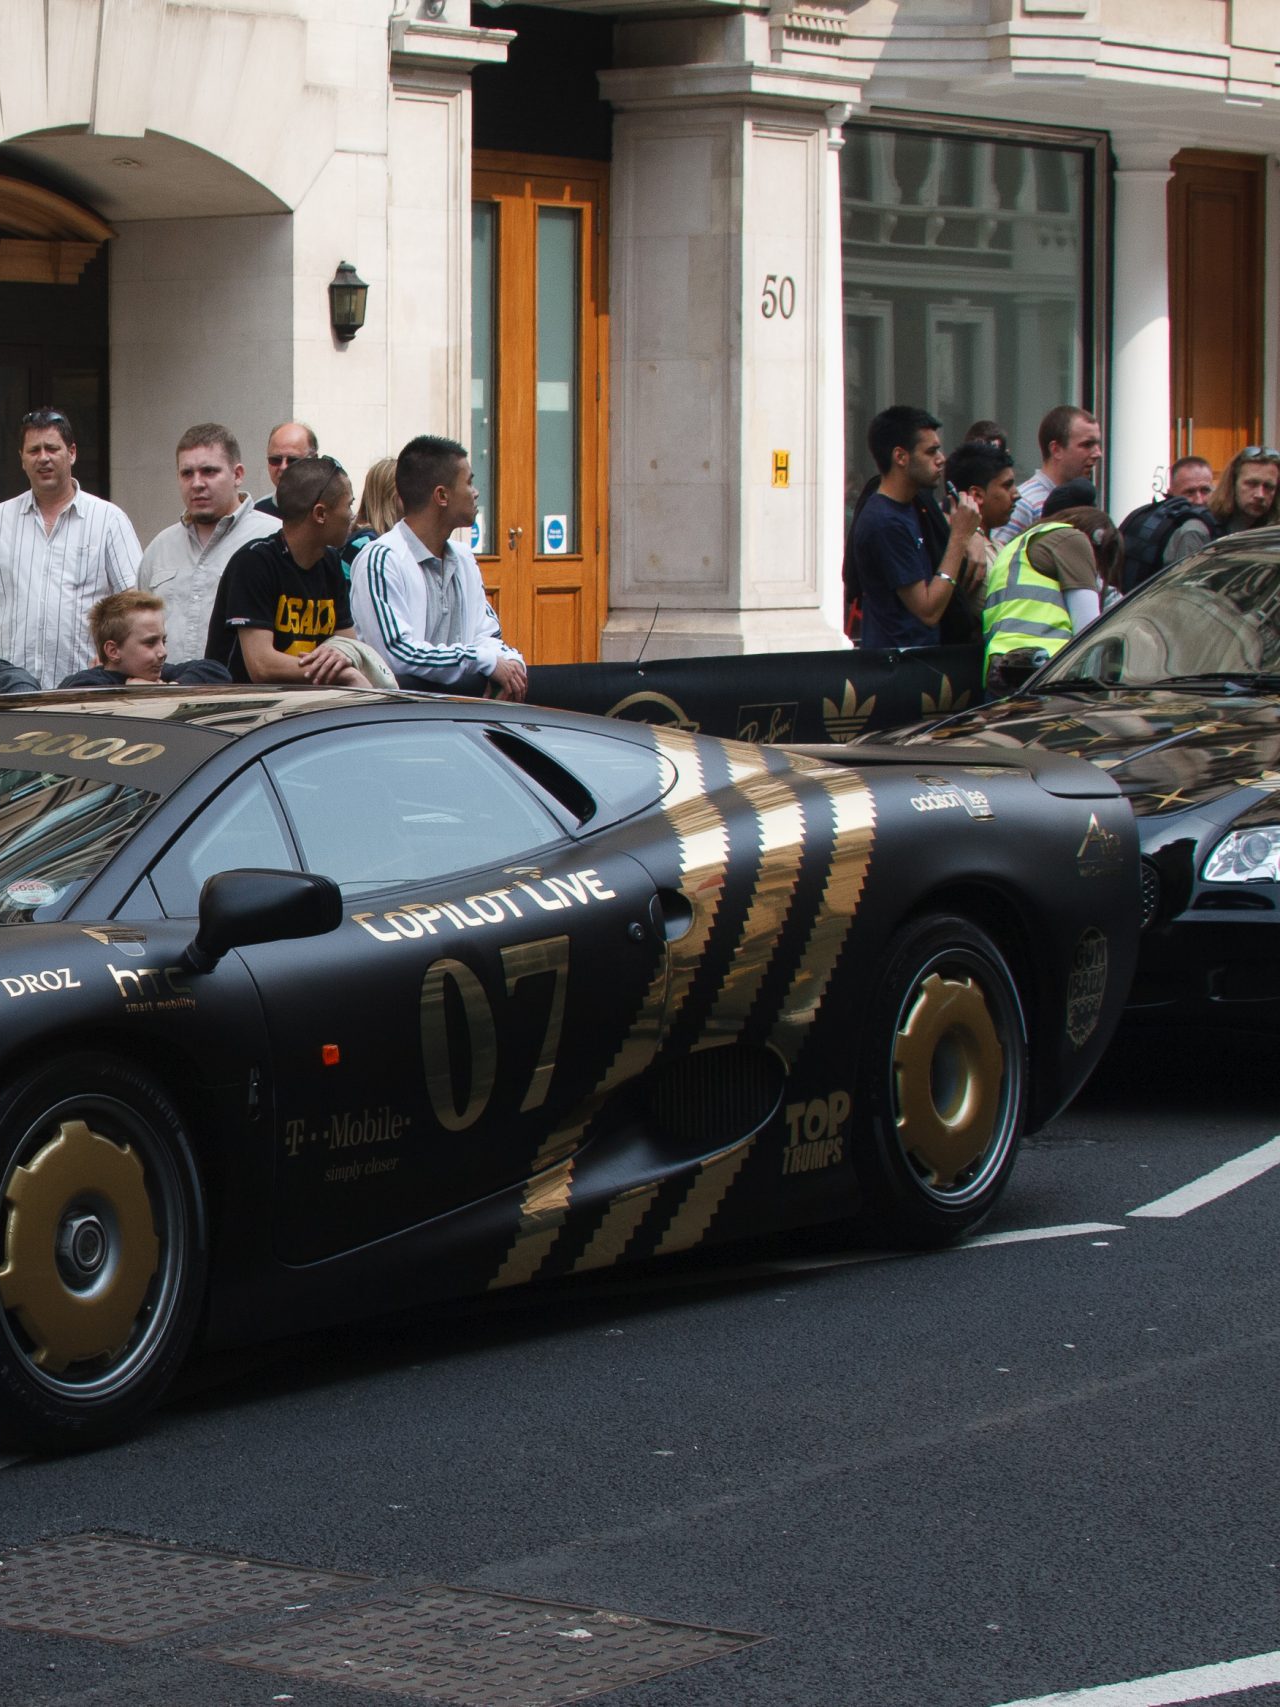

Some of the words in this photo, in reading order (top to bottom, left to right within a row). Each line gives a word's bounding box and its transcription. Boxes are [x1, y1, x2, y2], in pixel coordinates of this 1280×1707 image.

[761, 274, 795, 319] 50
[0, 967, 82, 999] DROZ
[125, 1001, 154, 1014] smart
[157, 998, 197, 1011] mobility
[420, 934, 570, 1132] 07
[786, 1090, 851, 1147] TOP
[324, 1160, 363, 1183] simply
[364, 1157, 400, 1176] closer
[782, 1136, 844, 1175] TRUMPS
